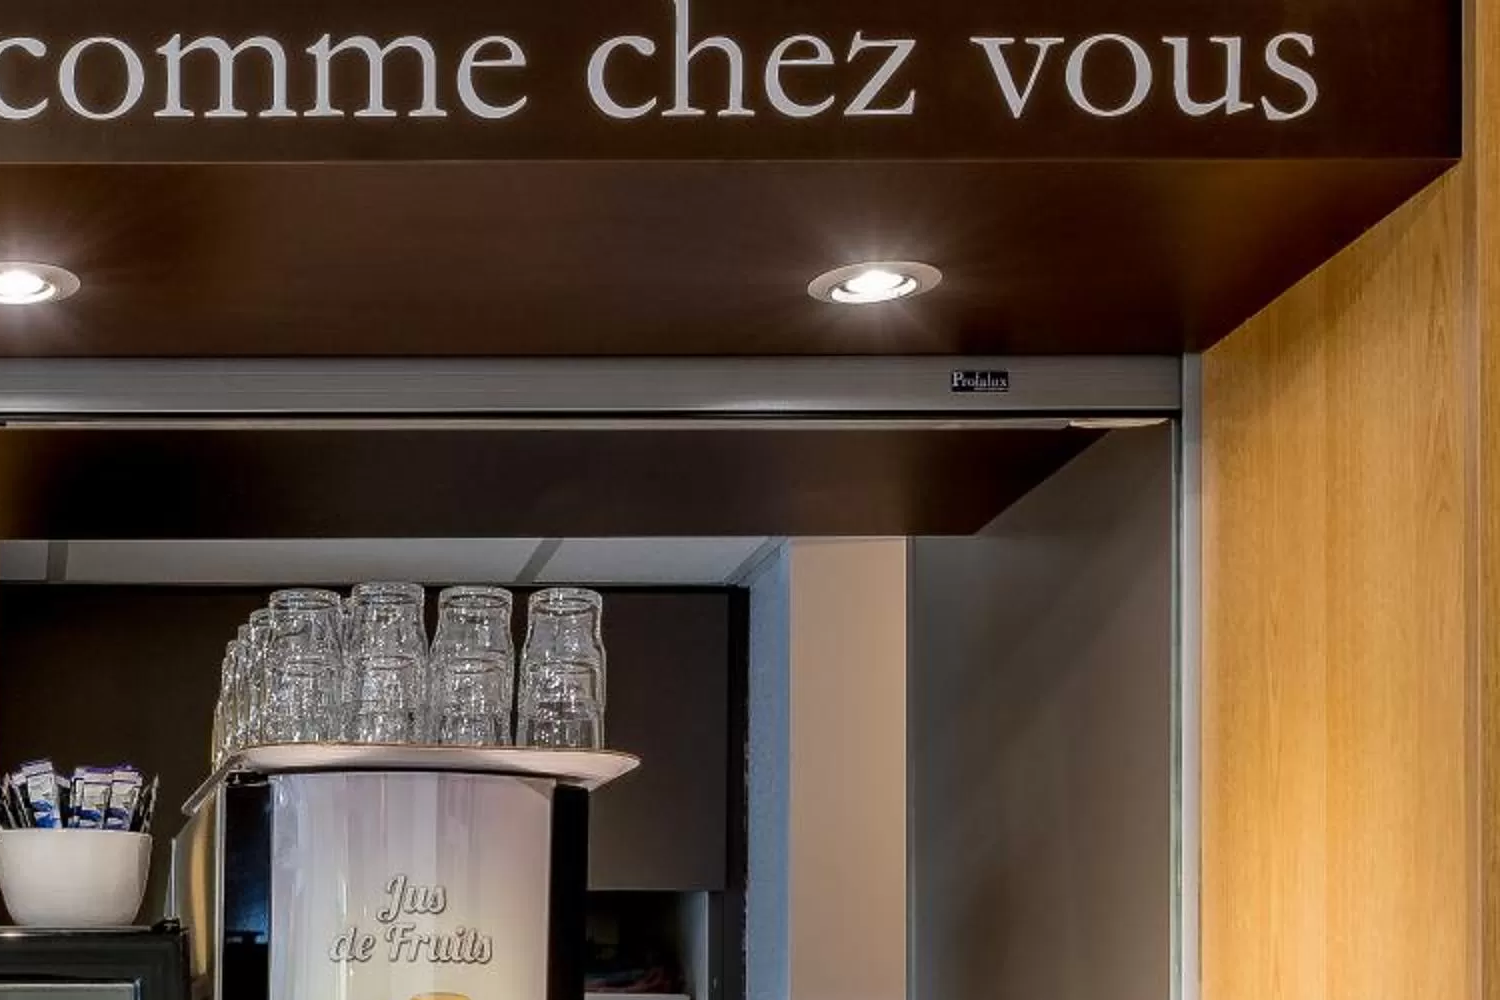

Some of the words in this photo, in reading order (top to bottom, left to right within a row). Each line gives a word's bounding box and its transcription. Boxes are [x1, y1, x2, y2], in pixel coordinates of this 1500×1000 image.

[586, 0, 916, 120] chez
[969, 31, 1320, 121] vous
[376, 873, 447, 922] Jus
[328, 926, 376, 963] de
[385, 922, 493, 964] Fruits
